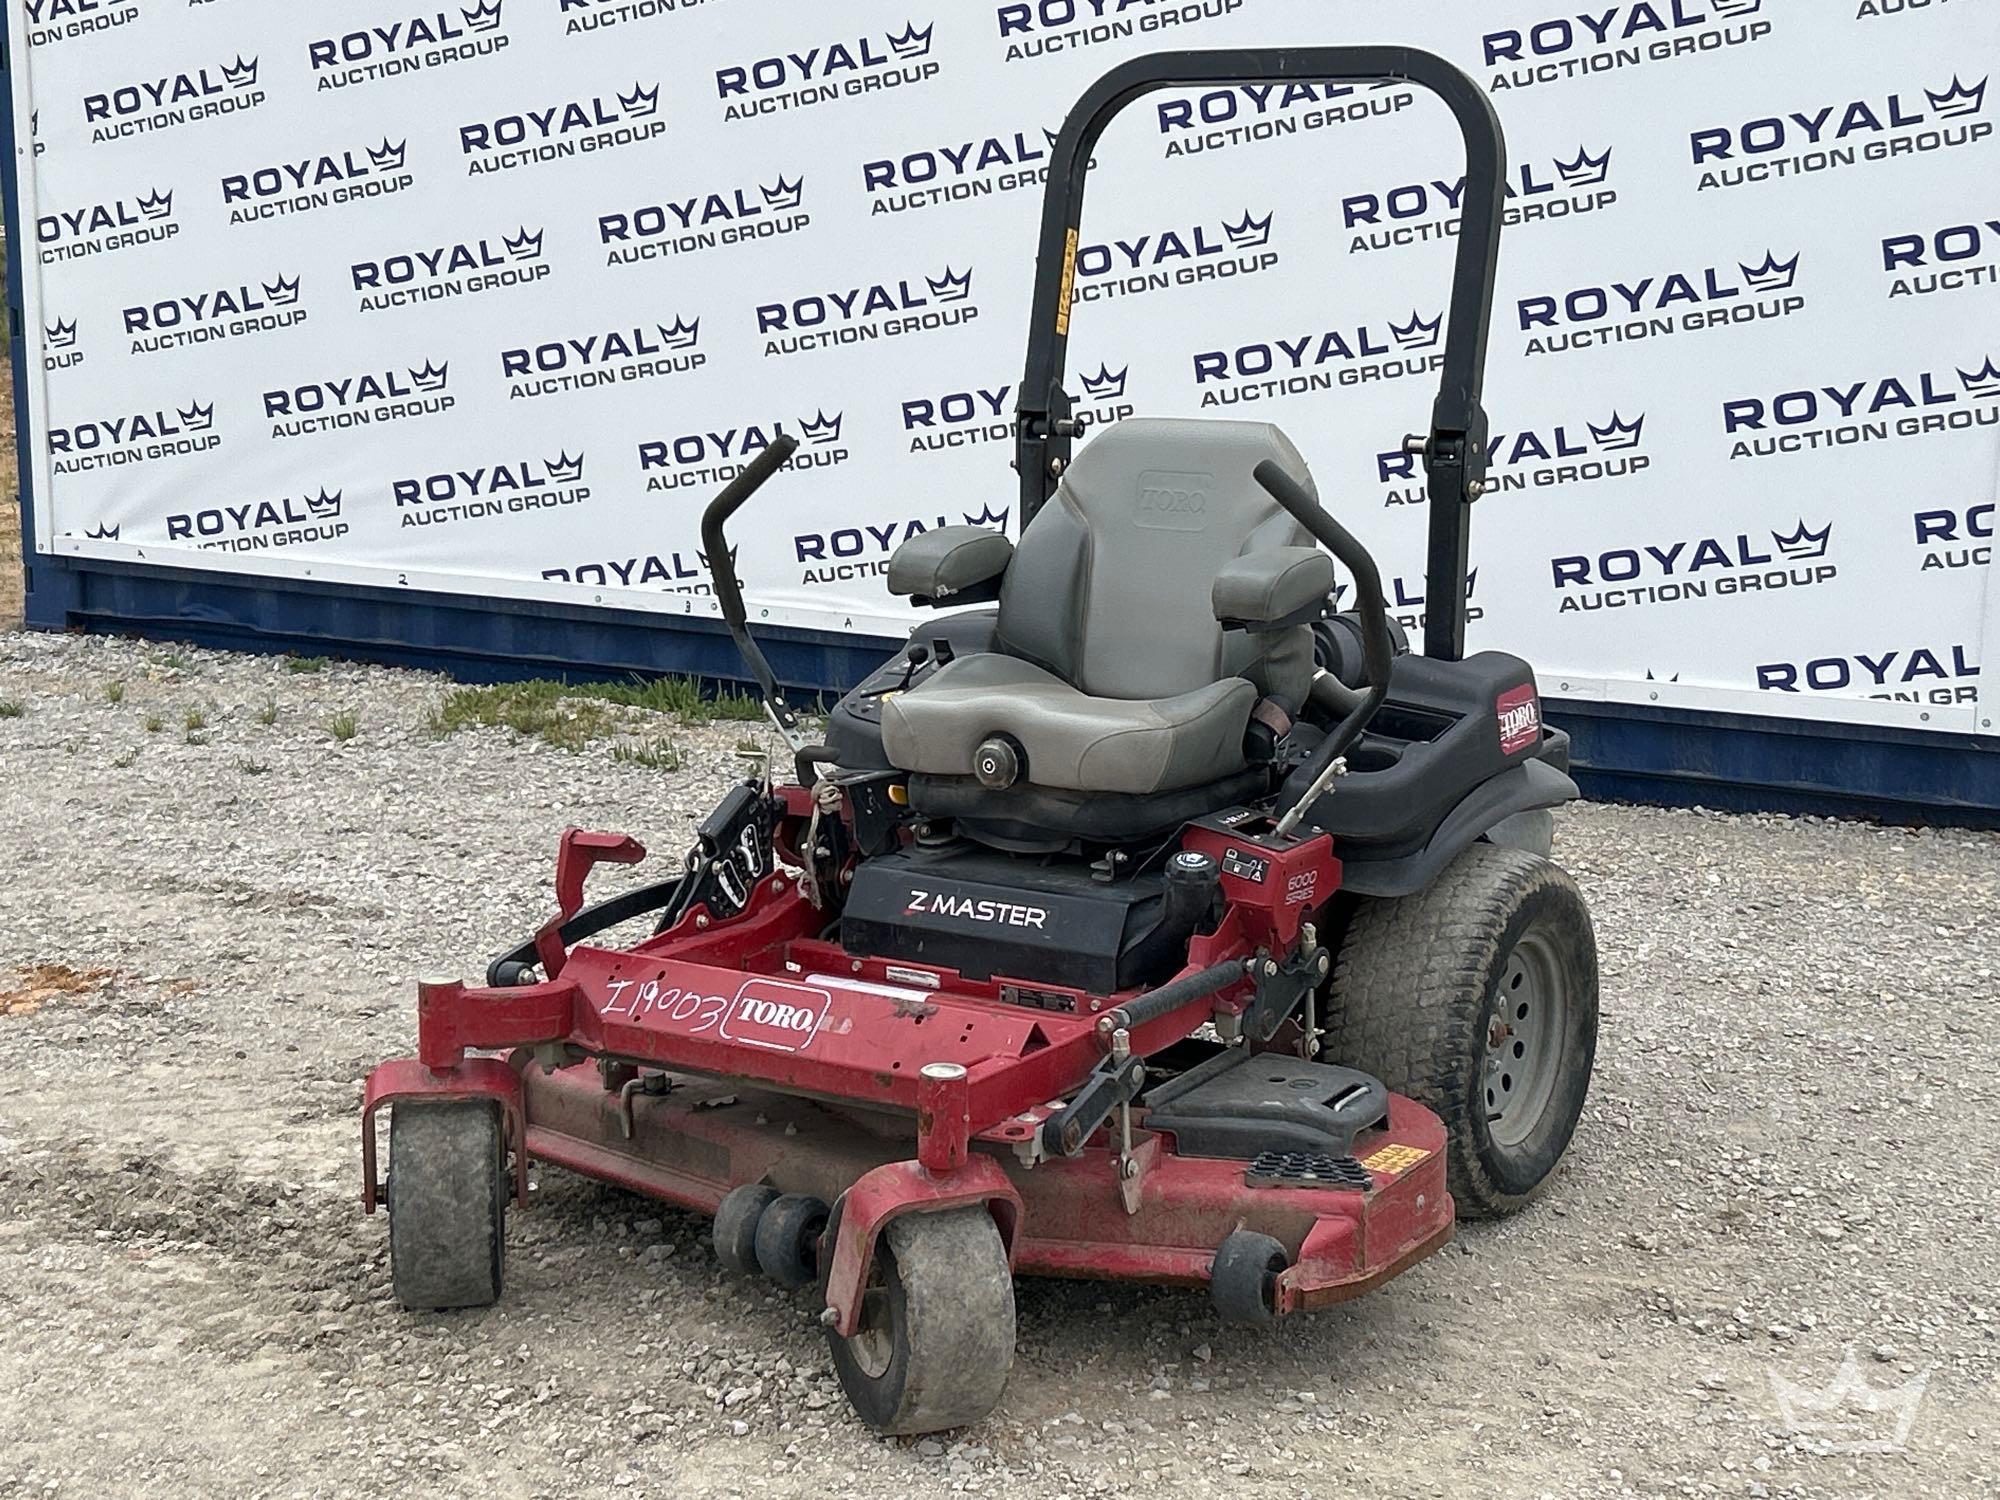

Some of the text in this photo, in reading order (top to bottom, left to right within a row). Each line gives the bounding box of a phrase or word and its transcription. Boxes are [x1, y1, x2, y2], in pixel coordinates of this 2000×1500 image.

[67, 8, 138, 37] GROUP
[309, 13, 463, 69] ROYAL
[1005, 19, 1132, 62] AUCTION
[1483, 0, 1705, 66] ROYAL
[318, 35, 508, 91] AUCTION GROUP
[716, 38, 888, 99] ROYAL
[1490, 21, 1771, 92] AUCTION GROUP
[84, 70, 223, 122] ROYAL
[725, 62, 939, 122] AUCTION GROUP
[93, 91, 265, 143] AUCTION GROUP
[460, 98, 619, 154] ROYAL
[1165, 93, 1413, 158] AUCTION GROUP
[1691, 95, 1924, 164] ROYAL
[469, 122, 665, 176] AUCTION GROUP
[863, 133, 1043, 192] ROYAL
[1698, 122, 1992, 191] AUCTION GROUP
[222, 152, 369, 203] ROYAL
[231, 175, 413, 224] AUCTION GROUP
[872, 179, 992, 216] AUCTION
[1342, 164, 1553, 229] ROYL
[599, 189, 761, 244] ROYAL
[608, 215, 809, 266] AUCTION GROUP
[1350, 190, 1617, 253] AUCTIO GROUP
[40, 224, 179, 264] CTION GROUP
[351, 240, 505, 290] ROYAL
[1076, 226, 1223, 277] OYAL
[1176, 253, 1278, 284] GROUP
[123, 287, 264, 334] ROYAL
[360, 265, 550, 312] AUCTION GROUP
[756, 281, 927, 334] ROYAL
[1517, 268, 1739, 330] ROYAL
[132, 310, 306, 354] AUCTION GROUP
[765, 307, 978, 357] AUCTION GROUP
[1525, 297, 1804, 356] AUCTION GROUP
[502, 329, 659, 377] ROYAL
[511, 354, 705, 399] AUCTION GROUP
[1194, 327, 1389, 383] ROYAL
[263, 372, 410, 418] ROYAL
[902, 386, 1080, 430] ROY
[1201, 373, 1331, 408] AUCTION
[1723, 373, 1956, 433] ROYAL
[47, 412, 179, 455] ROYAL
[272, 397, 455, 438] AUCTION GROUP
[1076, 404, 1134, 427] OUP
[54, 435, 220, 475] AUCTION GROUP
[778, 449, 849, 473] ROUP
[1730, 422, 1887, 459] AUCTION
[393, 462, 545, 506] ROYAL
[1385, 456, 1649, 507] AUON GROUP
[167, 499, 306, 540] ROYAL
[402, 488, 590, 527] AUCTION GROUP
[273, 523, 348, 546] GROUP
[802, 560, 891, 585] AUCTIO
[1551, 535, 1771, 588] ROYAL
[1560, 566, 1836, 613] AUCTION GROUP
[1756, 645, 1980, 692] ROYAL
[1288, 870, 1318, 891] 6000
[908, 890, 1047, 929] Z MASTER
